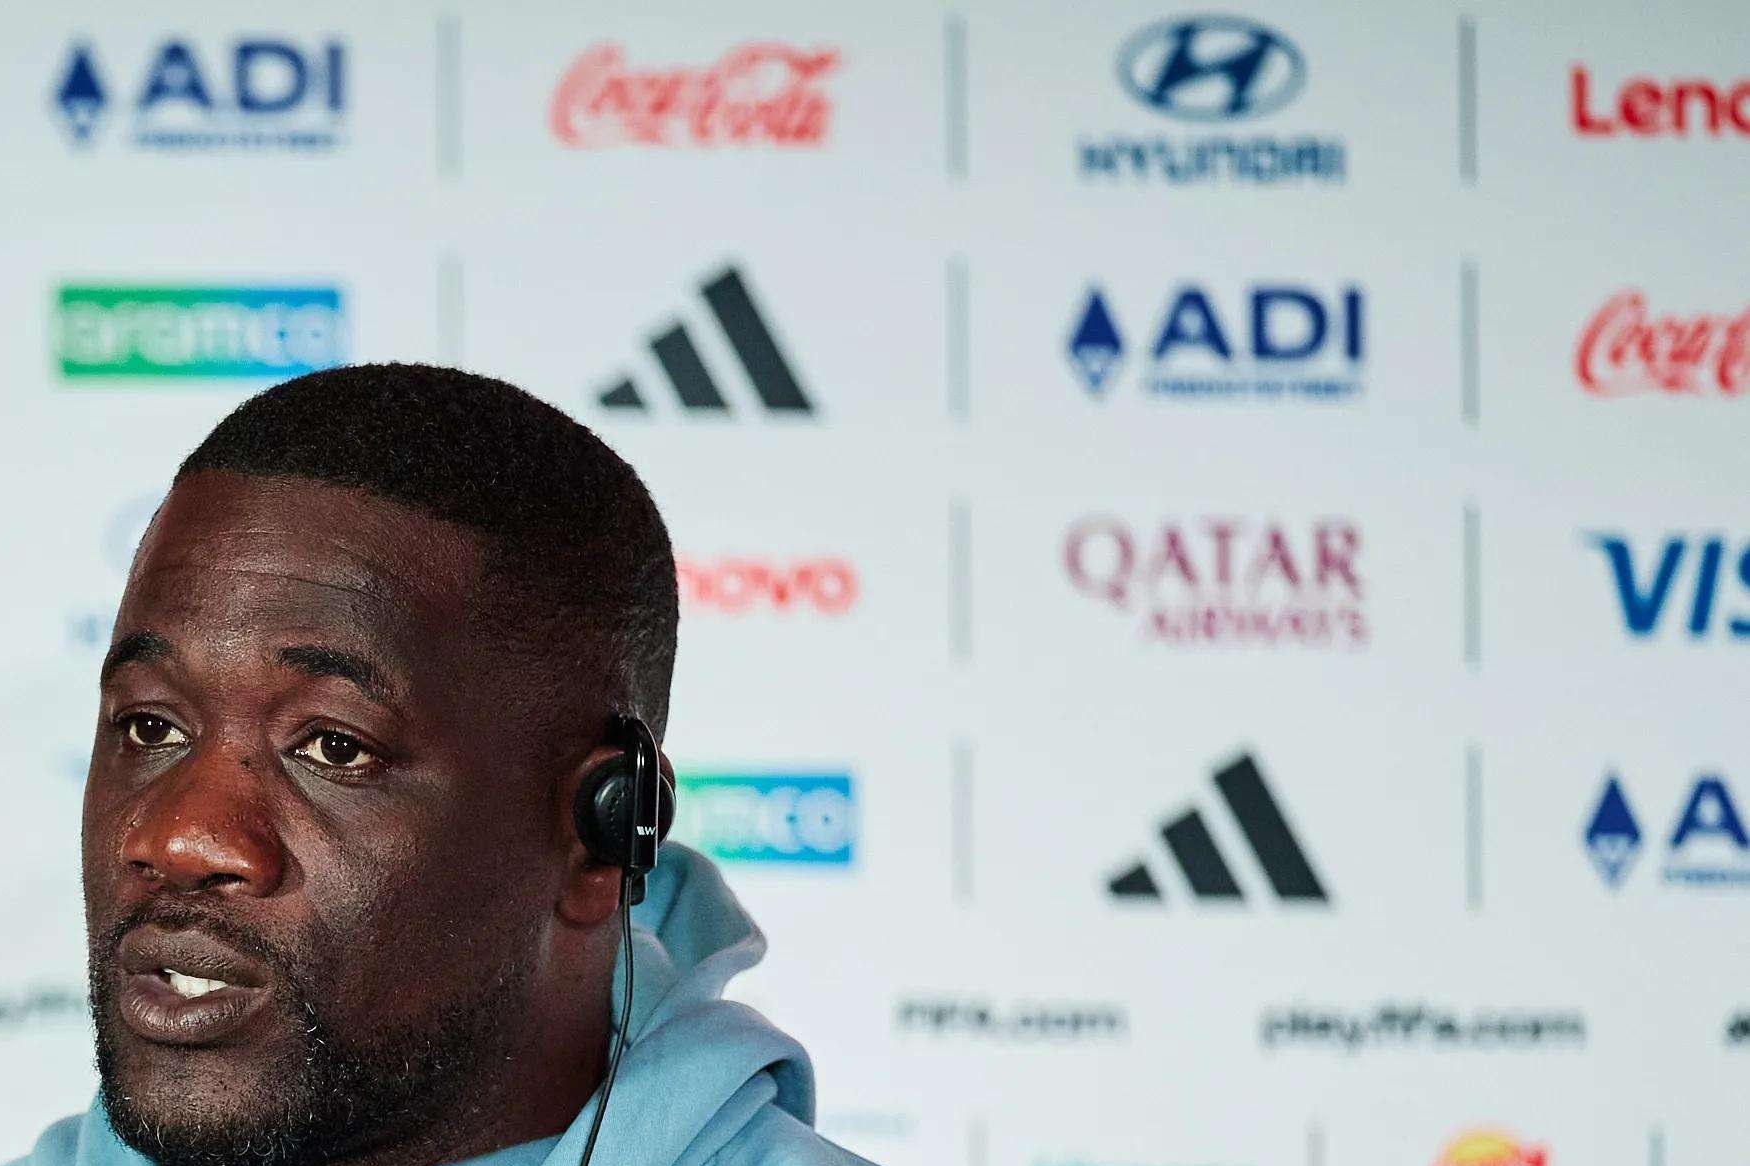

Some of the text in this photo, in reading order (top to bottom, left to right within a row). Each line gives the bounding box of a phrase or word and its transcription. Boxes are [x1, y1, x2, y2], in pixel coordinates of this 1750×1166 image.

[136, 39, 347, 113] ADI
[1079, 136, 1347, 184] HYUNDAI
[59, 302, 334, 366] aramco
[1150, 284, 1364, 360] ADI
[1062, 515, 1362, 604] QATAR
